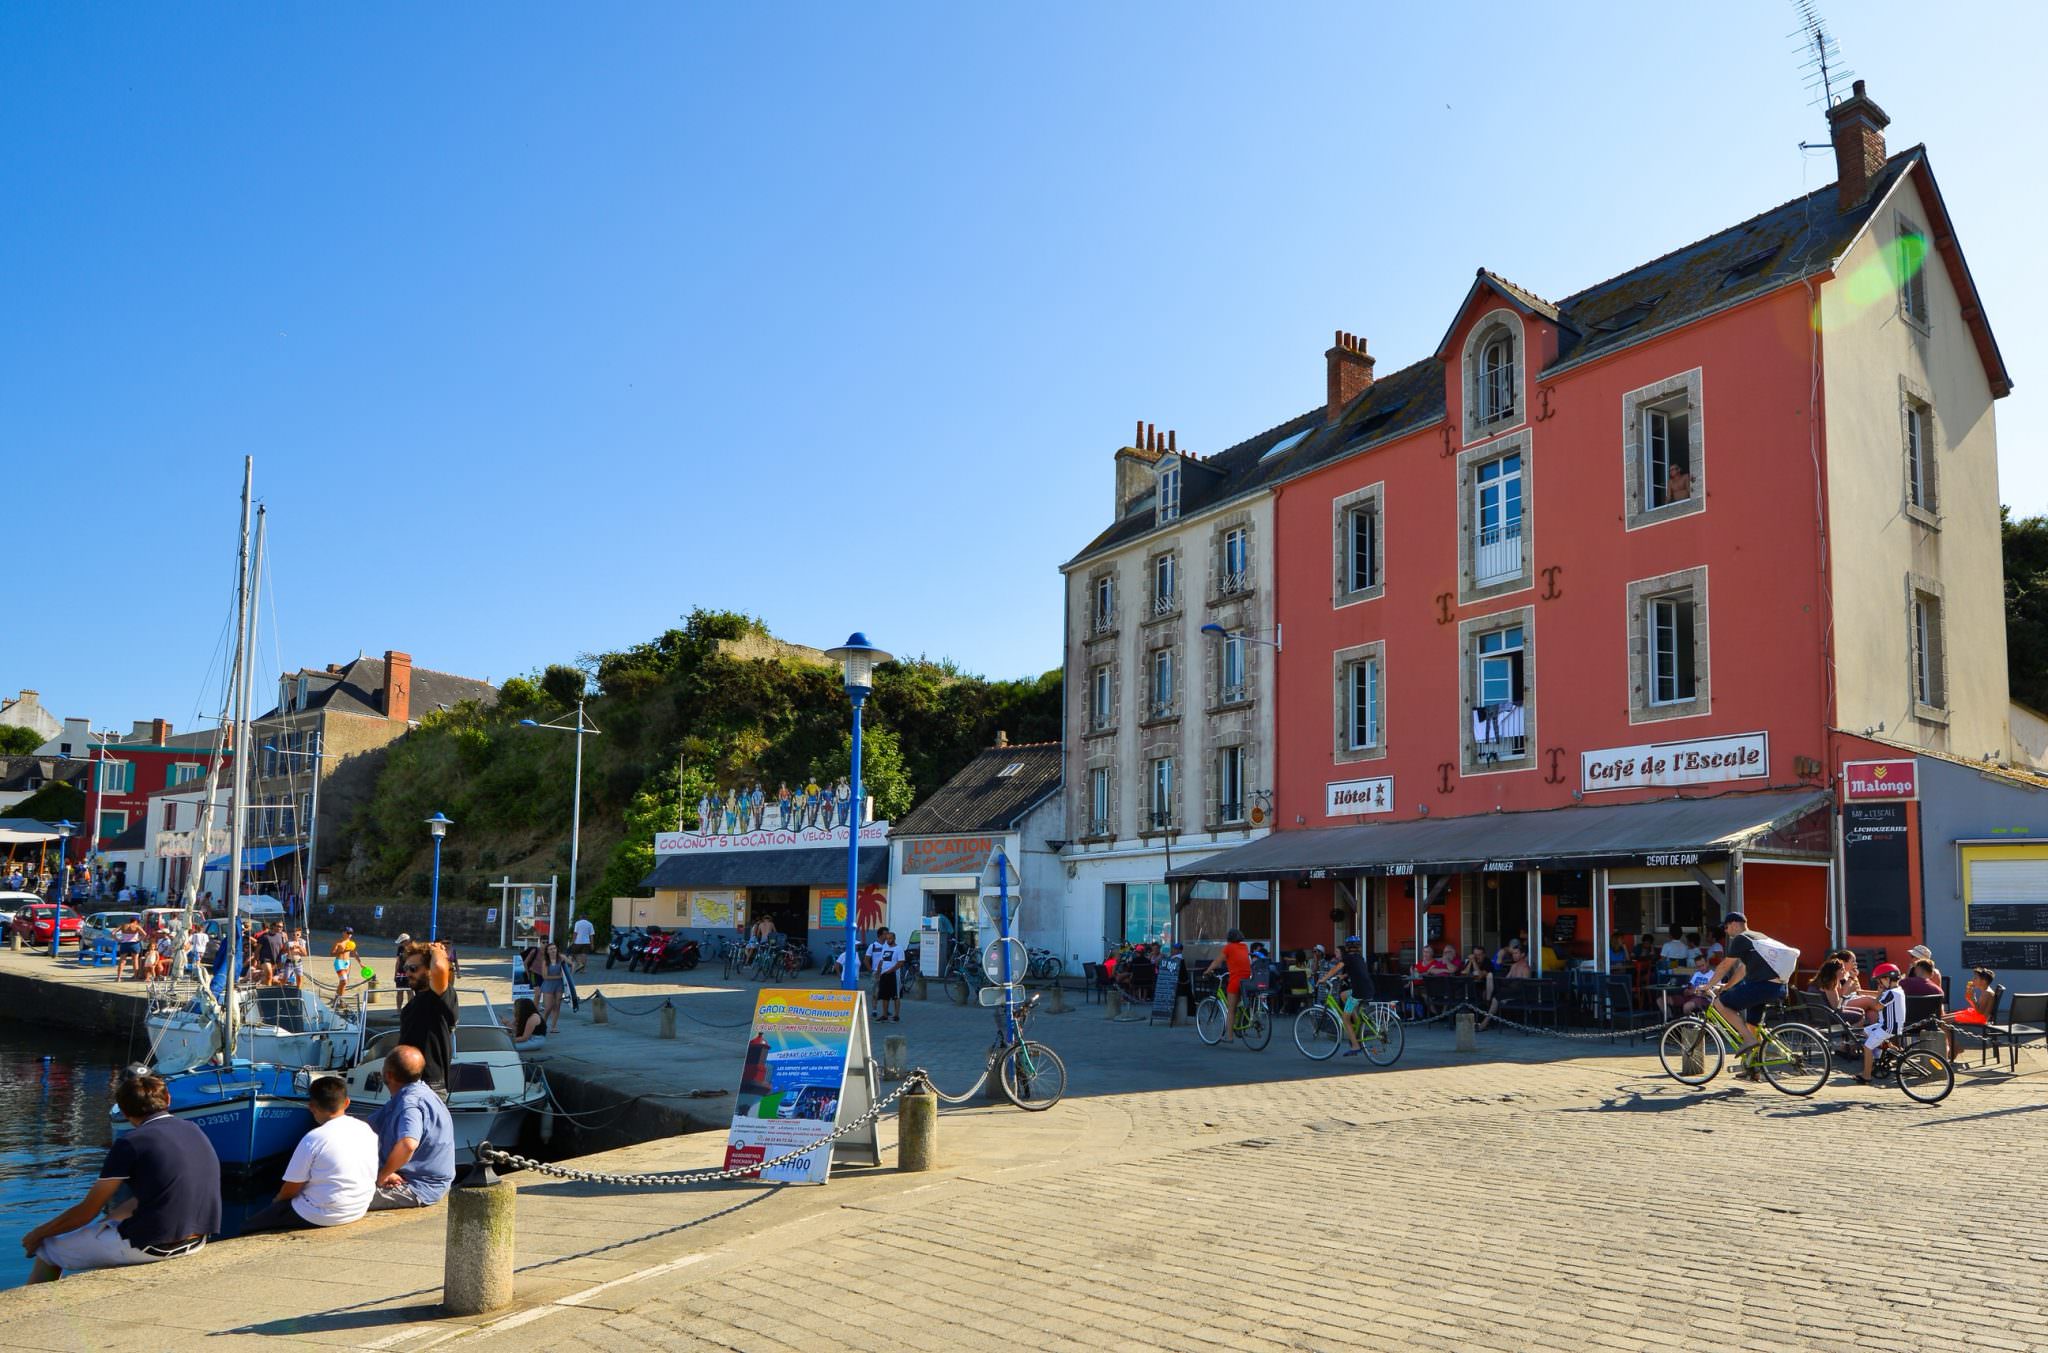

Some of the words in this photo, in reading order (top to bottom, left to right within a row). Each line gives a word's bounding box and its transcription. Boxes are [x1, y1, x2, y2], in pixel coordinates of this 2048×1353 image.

[1589, 758, 1635, 781] Café
[1640, 756, 1666, 775] de
[1672, 746, 1760, 771] l'Escale
[1851, 780, 1912, 794] Malongo
[1333, 787, 1371, 805] Hôtel
[659, 834, 728, 849] COCONUT'S
[732, 831, 797, 848] LOCATION
[803, 830, 833, 841] VELOS
[837, 828, 882, 841] VOURES
[914, 838, 992, 855] LOCATION
[1669, 854, 1680, 865] DE
[1680, 853, 1698, 865] PAIN
[1386, 866, 1395, 876] LE
[1488, 861, 1513, 872] MANGER
[759, 1005, 786, 1014] GROIX
[788, 1006, 850, 1017] PANORAMIQUE
[207, 1112, 240, 1125] 292617
